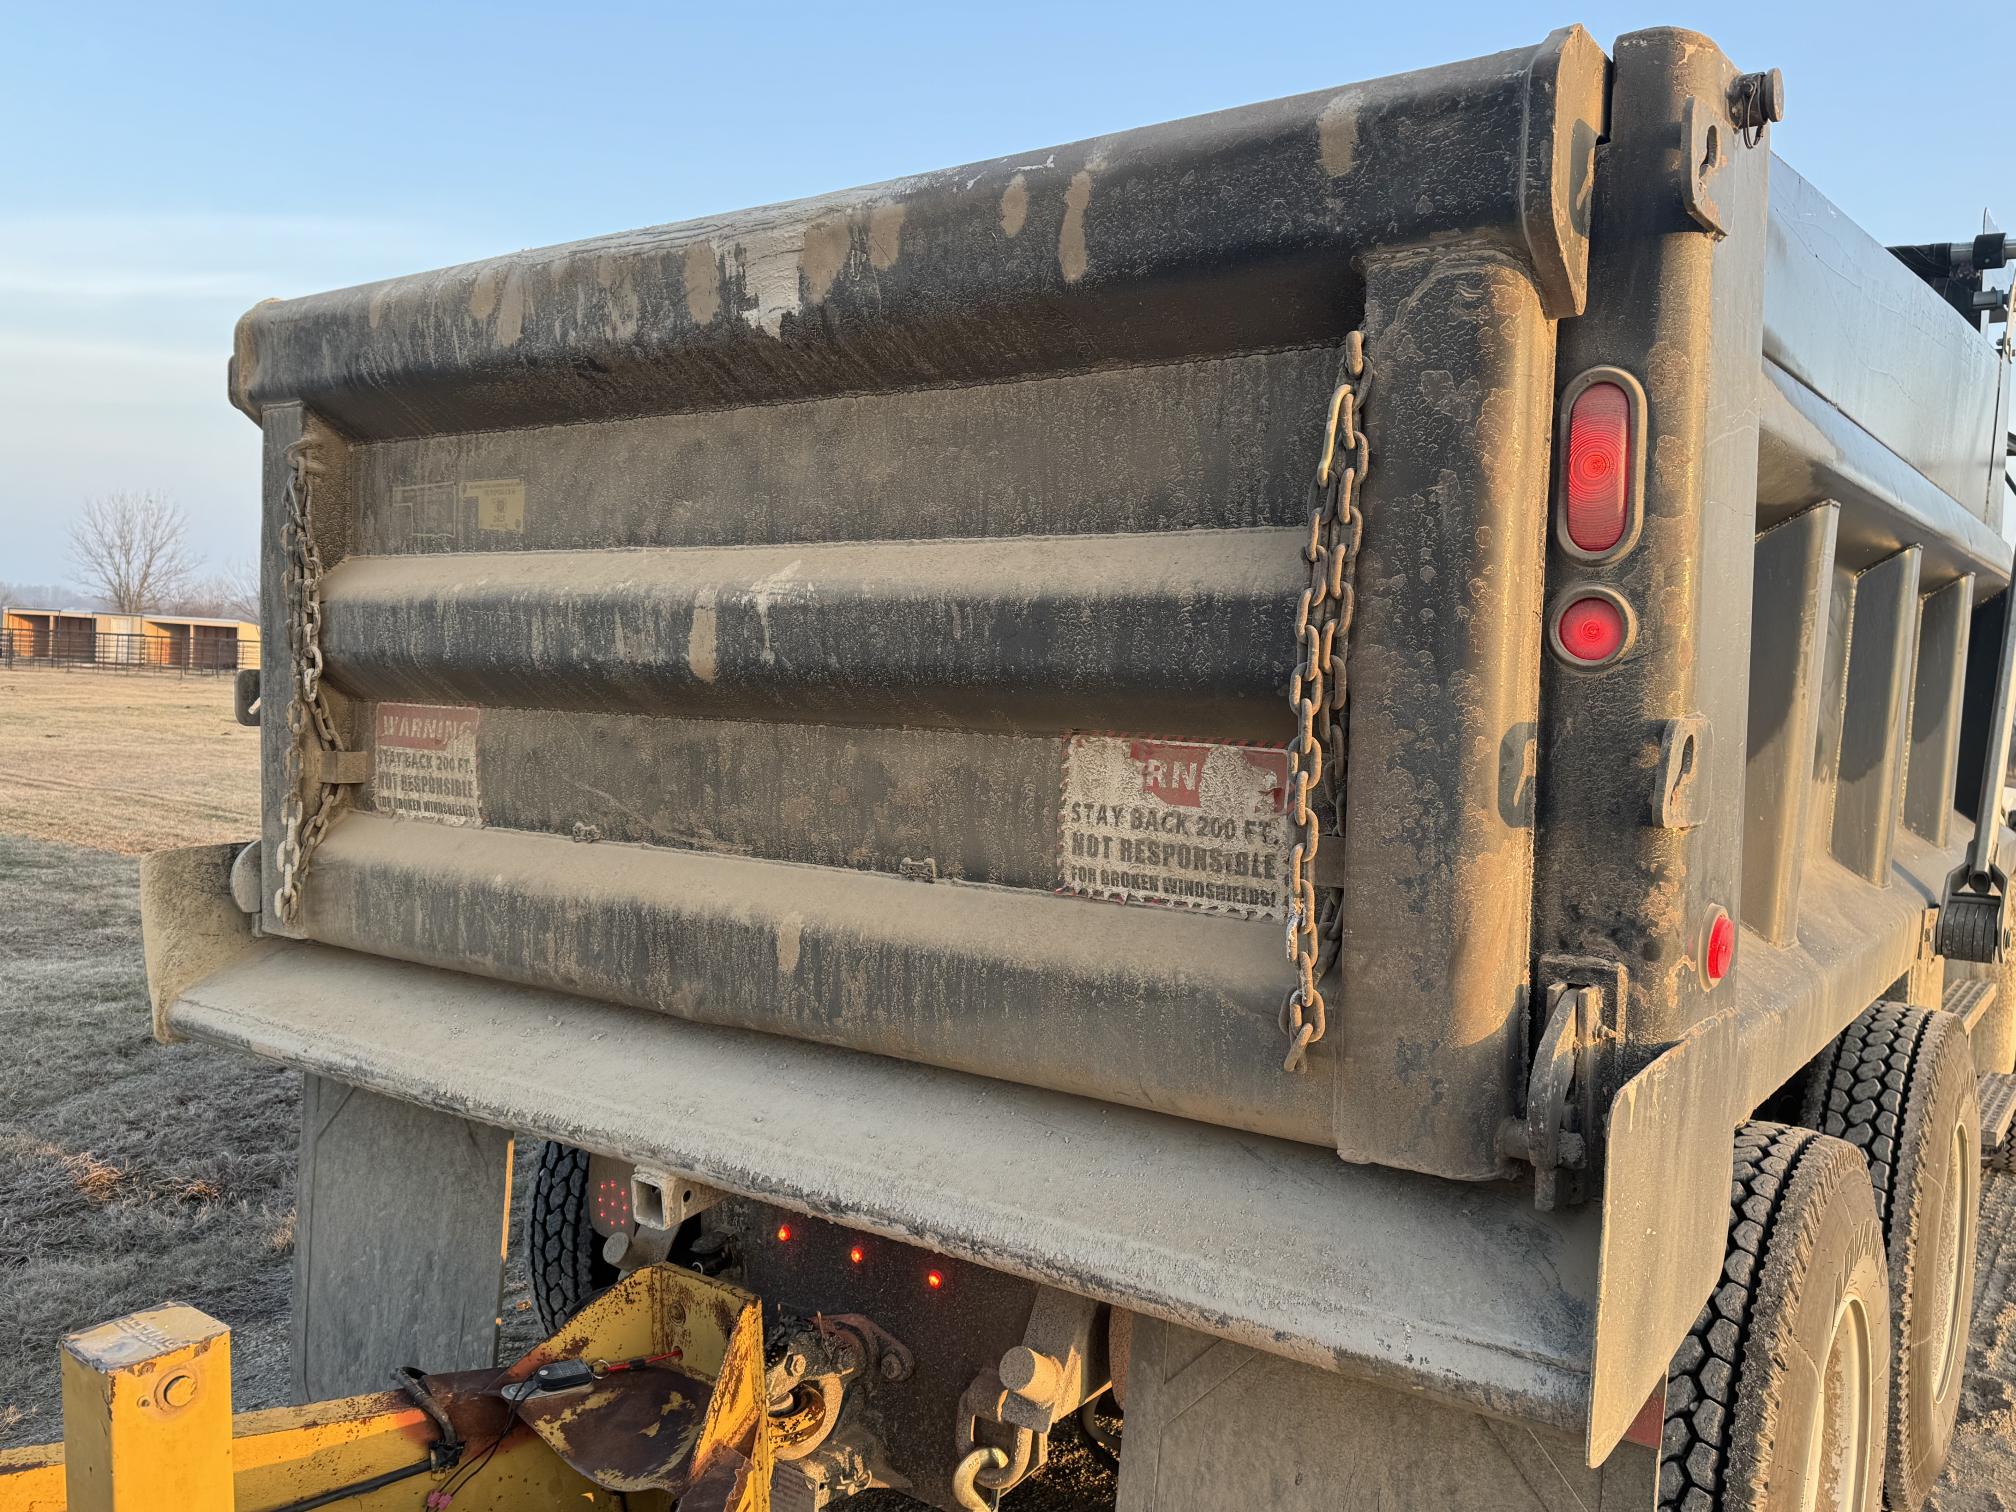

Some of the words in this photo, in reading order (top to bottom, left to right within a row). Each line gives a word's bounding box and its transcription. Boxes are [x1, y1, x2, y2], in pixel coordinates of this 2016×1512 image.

[383, 714, 473, 743] WARNING
[404, 751, 433, 770] BACK
[436, 755, 455, 771] 200
[400, 774, 473, 799] RESPONSIBLE
[1071, 801, 1124, 828] STAY
[1129, 806, 1188, 837] BACK
[1197, 815, 1237, 839] 200
[1071, 831, 1113, 859] NOT
[1120, 838, 1276, 880] RESPONSIBLE
[1071, 864, 1097, 883] FOR
[1101, 869, 1159, 892] BROKEN
